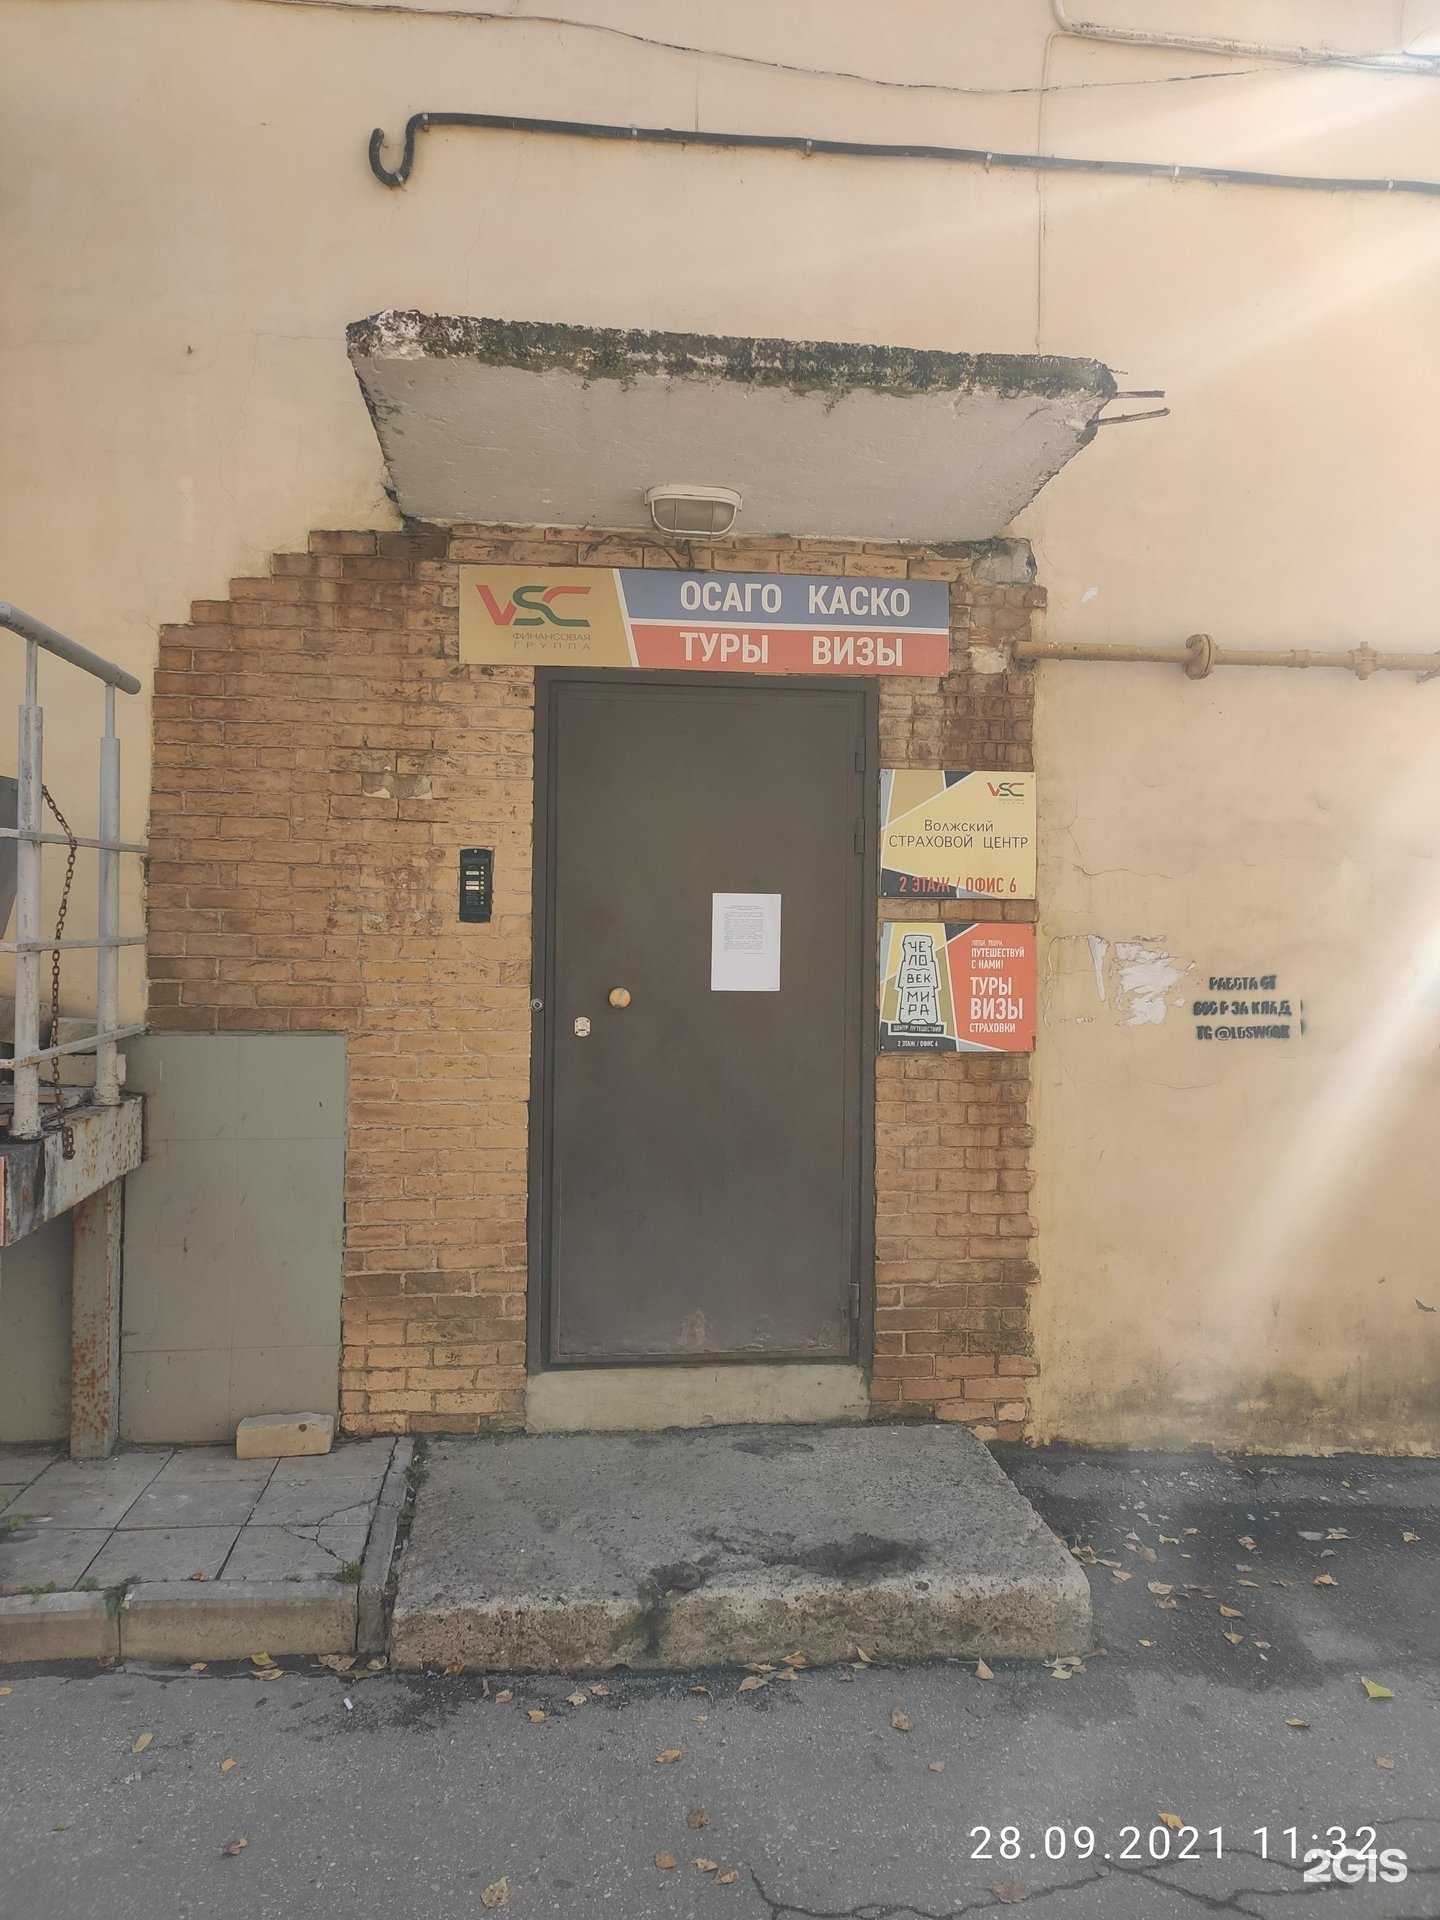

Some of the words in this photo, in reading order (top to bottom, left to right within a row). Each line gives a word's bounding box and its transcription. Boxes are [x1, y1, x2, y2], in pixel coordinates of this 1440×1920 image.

[680, 580, 782, 614] ОСАГО
[808, 585, 911, 617] КАСКО
[475, 585, 592, 627] VSC
[512, 632, 591, 641] ФИНАНСОВАЯ
[679, 631, 769, 664] ТУРЫ
[812, 635, 904, 667] ВИЗЫ
[987, 782, 1025, 797] VSC
[924, 818, 994, 832] Волжский
[888, 833, 973, 848] СТРАХОВОЙ
[983, 836, 1029, 850] ЦЕНТР
[899, 877, 908, 892] 2
[912, 876, 950, 893] ЭТАЖ
[965, 877, 1004, 893] ОФИС
[1009, 877, 1017, 893] 6
[908, 941, 927, 953] ЧЕ
[971, 946, 1025, 958] ПУТЕШЕСТВУЙ
[908, 954, 928, 966] ЛО
[971, 959, 976, 969] С
[906, 973, 931, 984] ВЕК
[970, 976, 1012, 996] ТУРЫ
[907, 991, 930, 1003] МИ
[908, 1004, 930, 1016] РА
[970, 998, 1023, 1020] ВИЗЫ
[1231, 1000, 1249, 1015] ЗА
[969, 1022, 1016, 1033] СТРАХОВКИ
